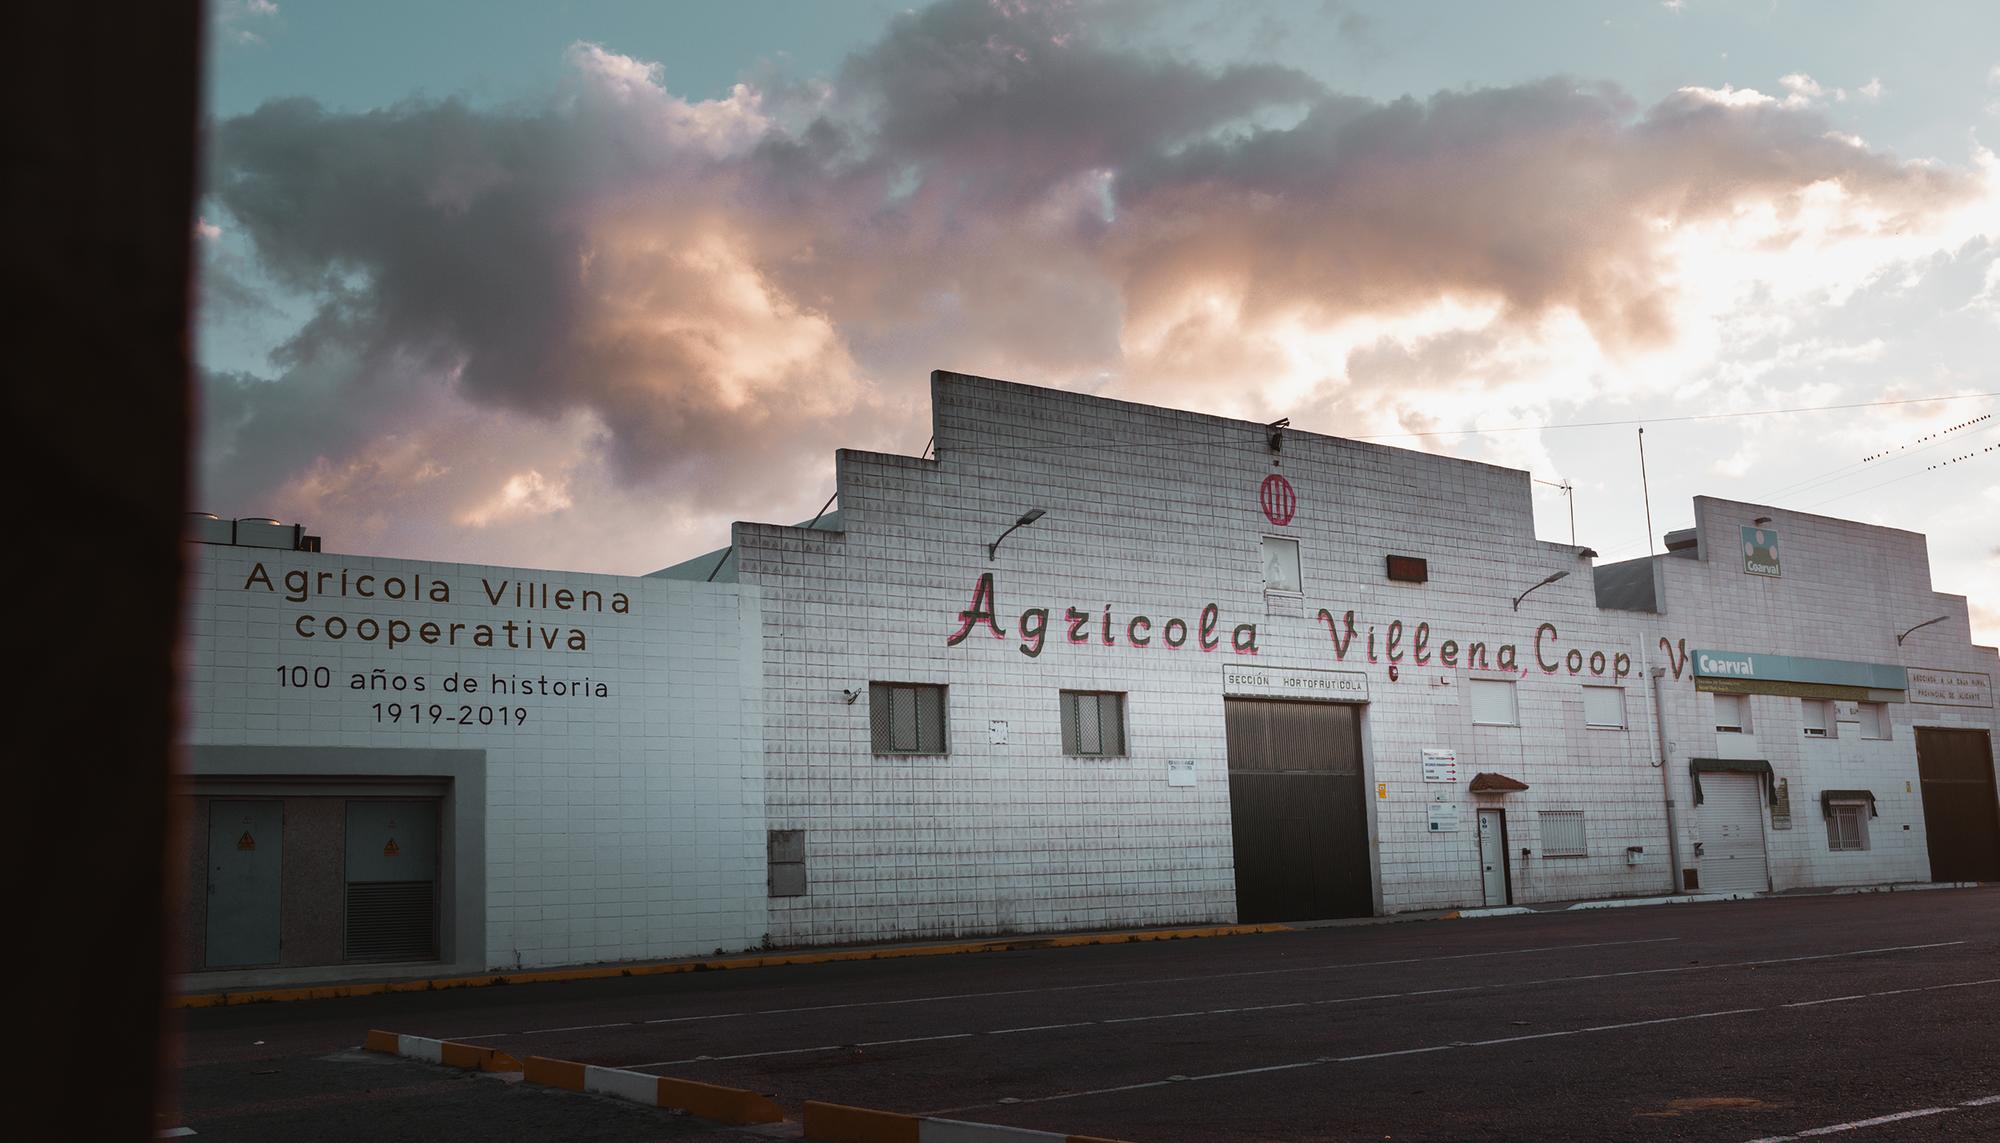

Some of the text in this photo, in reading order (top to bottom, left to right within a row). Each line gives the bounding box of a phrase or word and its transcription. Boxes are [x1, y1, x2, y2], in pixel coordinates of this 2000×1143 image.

[1747, 560, 1780, 575] Coarval
[244, 562, 630, 615] Agrícola Villena
[295, 613, 587, 651] cooperativa
[1533, 622, 1643, 685] Coop.
[1700, 654, 1754, 676] Coarval
[276, 665, 609, 698] 100 años de historia
[1229, 672, 1269, 686] SECCIÓN
[373, 703, 528, 727] 1919-2019
